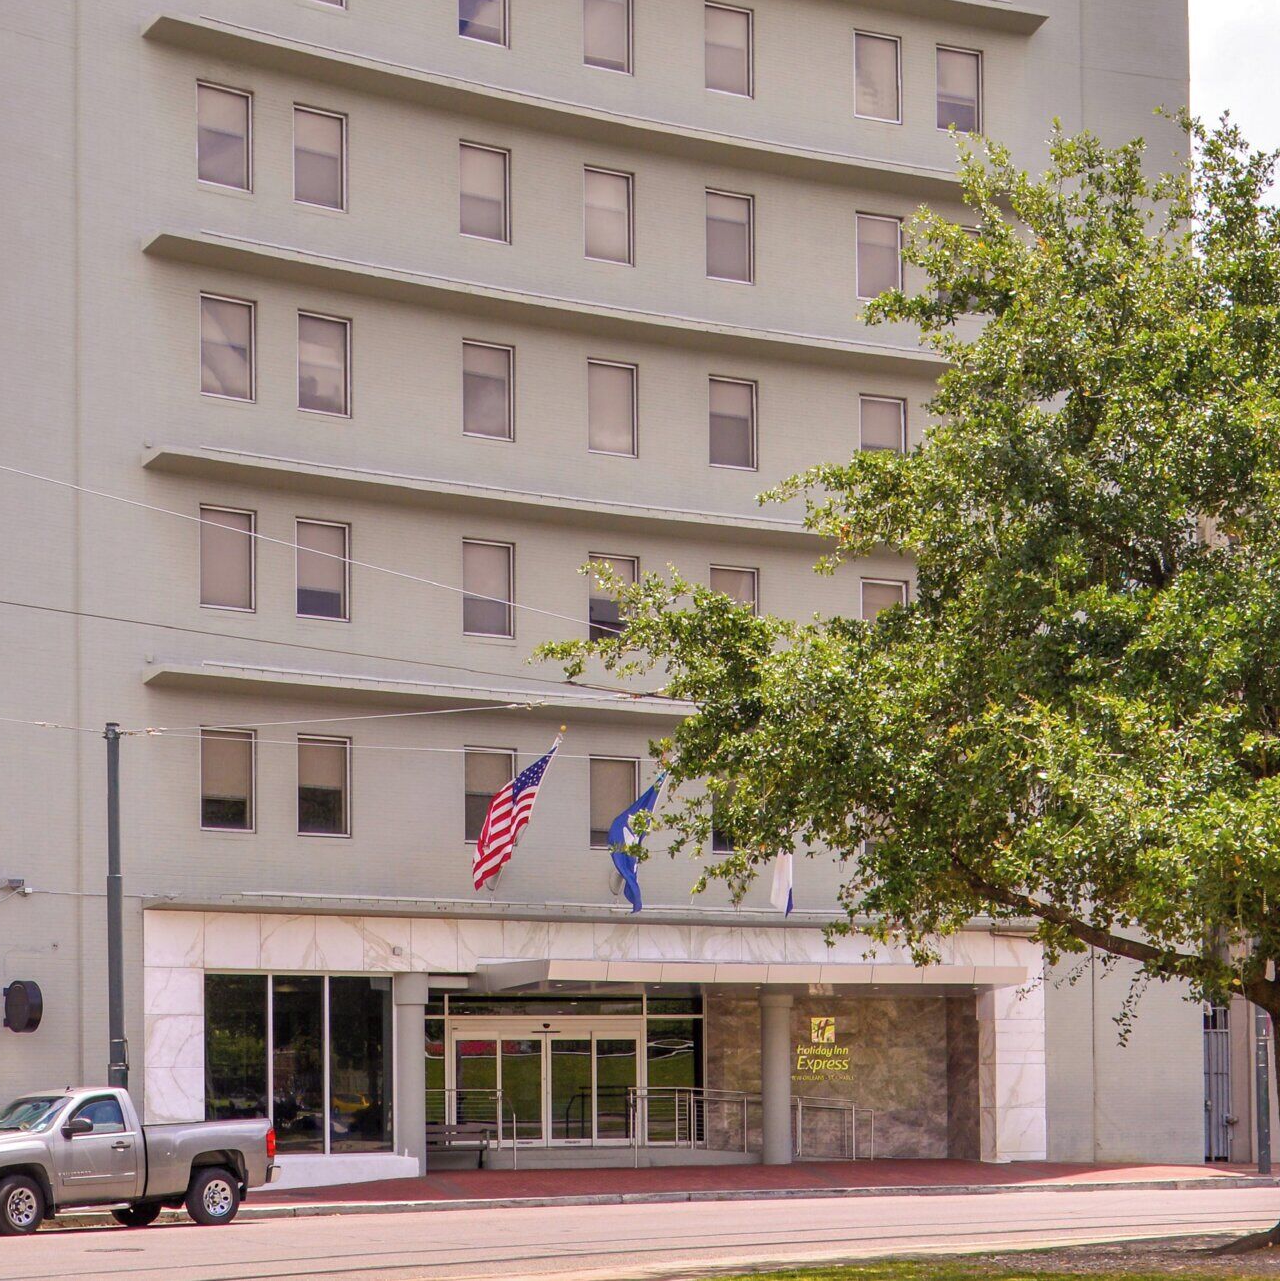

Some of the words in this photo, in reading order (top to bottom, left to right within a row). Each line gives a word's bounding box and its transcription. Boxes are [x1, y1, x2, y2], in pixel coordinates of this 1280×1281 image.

[797, 1045, 833, 1057] Holiday
[833, 1044, 849, 1055] Inn
[797, 1055, 849, 1073] Express
